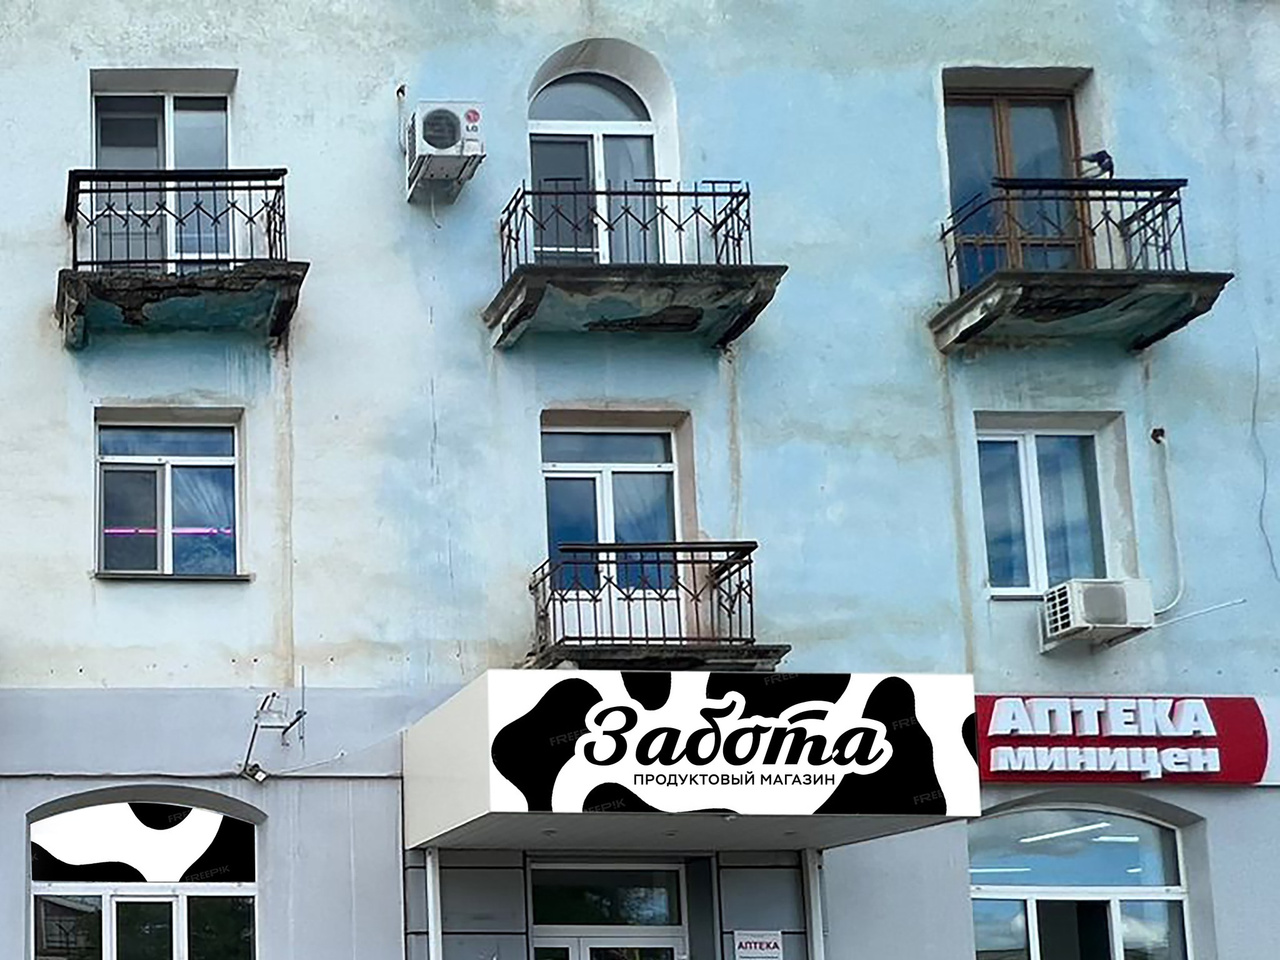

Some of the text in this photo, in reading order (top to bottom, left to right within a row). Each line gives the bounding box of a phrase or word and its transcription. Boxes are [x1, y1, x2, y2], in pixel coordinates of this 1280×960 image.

[465, 124, 479, 133] LG
[988, 697, 1218, 737] АПТЕКА
[583, 699, 885, 767] Забота
[633, 770, 836, 788] ПРОДУКТОВЫЙ МАГАЗИН
[737, 941, 780, 951] АПТЕКА
